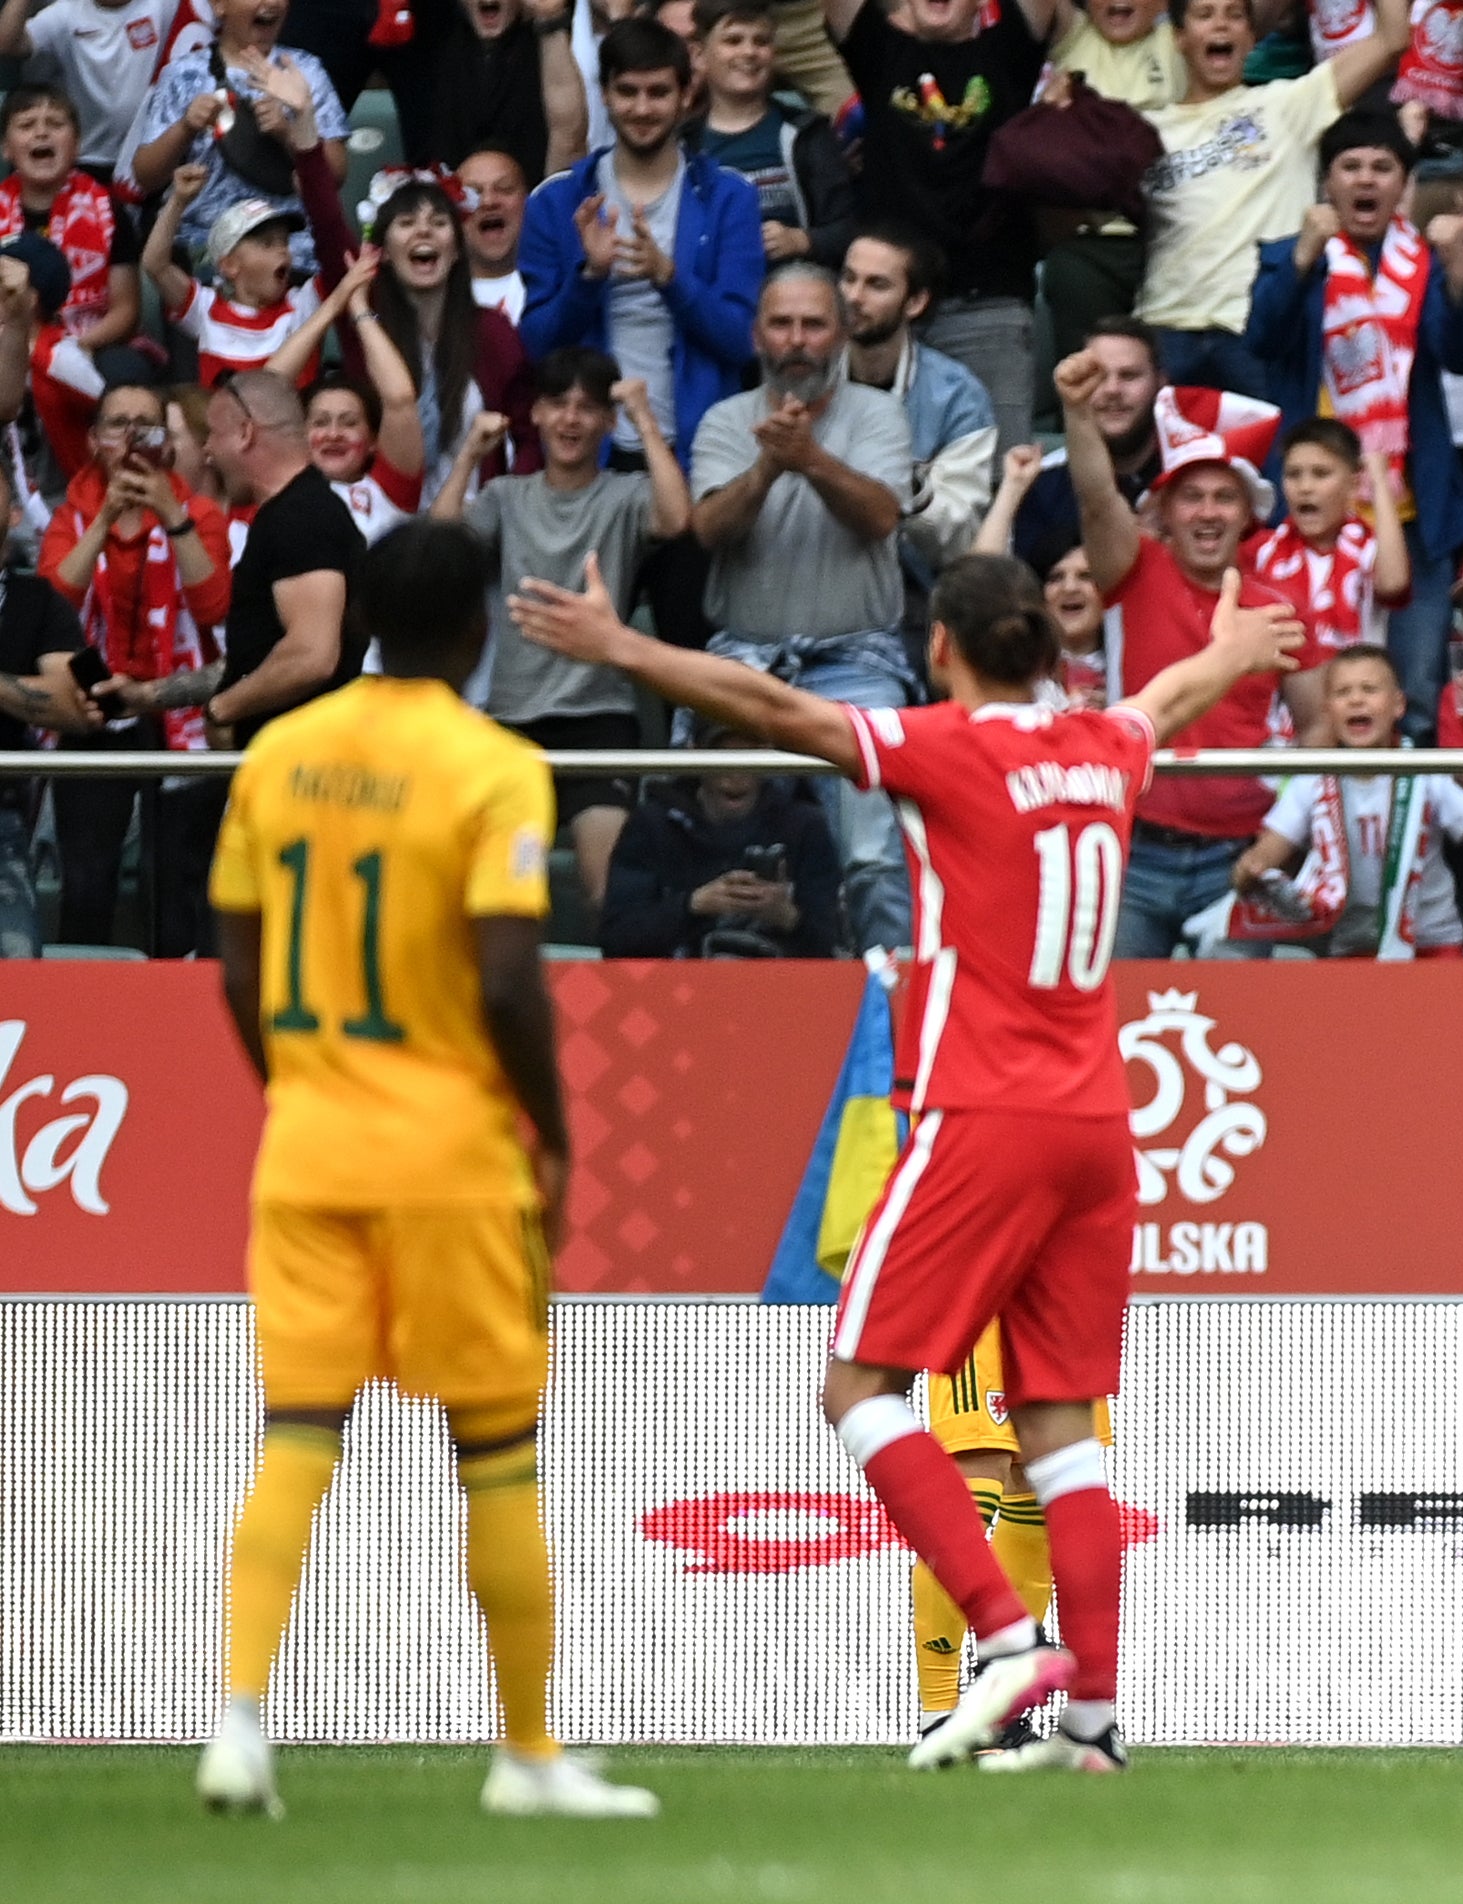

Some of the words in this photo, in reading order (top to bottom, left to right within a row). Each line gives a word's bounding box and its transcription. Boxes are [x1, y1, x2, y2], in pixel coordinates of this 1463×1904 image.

[1026, 821, 1123, 993] 10
[1357, 815, 1390, 857] 11
[270, 838, 406, 1042] 11
